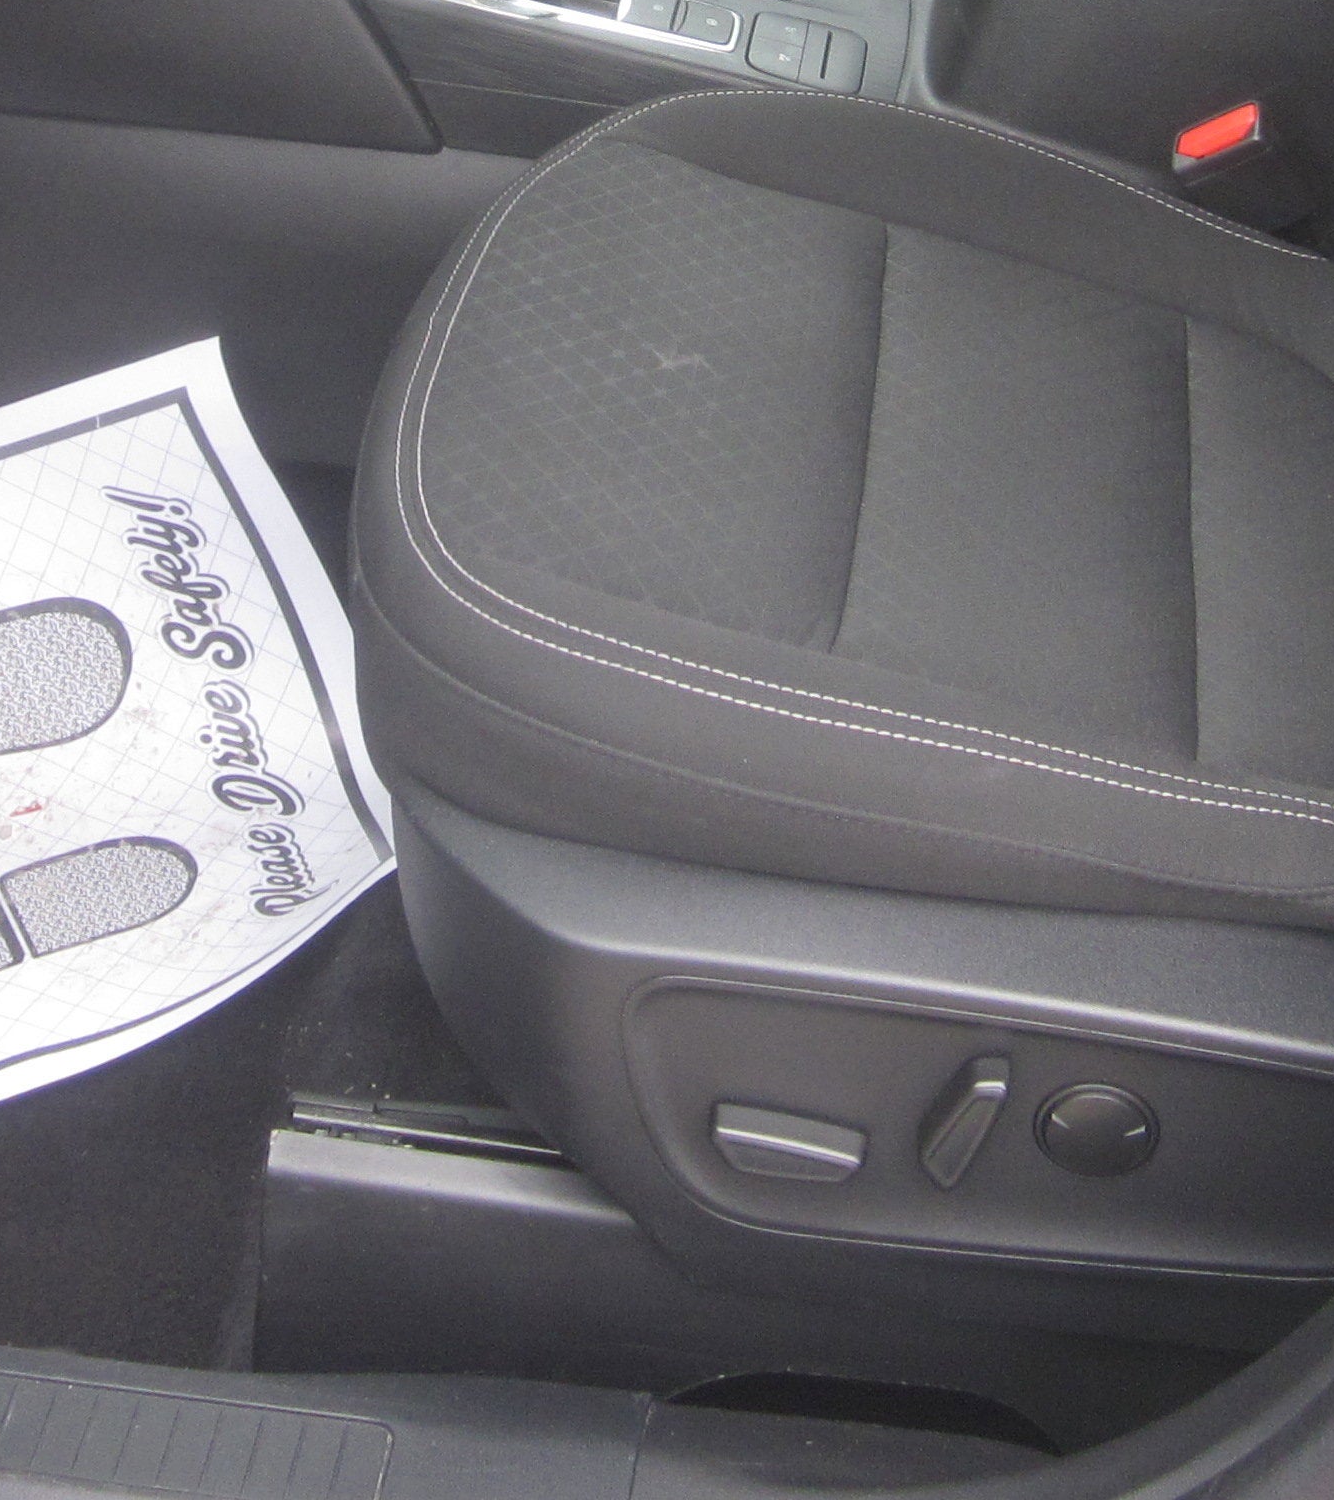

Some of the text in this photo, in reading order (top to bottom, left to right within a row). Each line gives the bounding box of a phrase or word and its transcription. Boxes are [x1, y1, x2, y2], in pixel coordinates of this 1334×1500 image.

[104, 493, 335, 917] Please Drive Safely!
